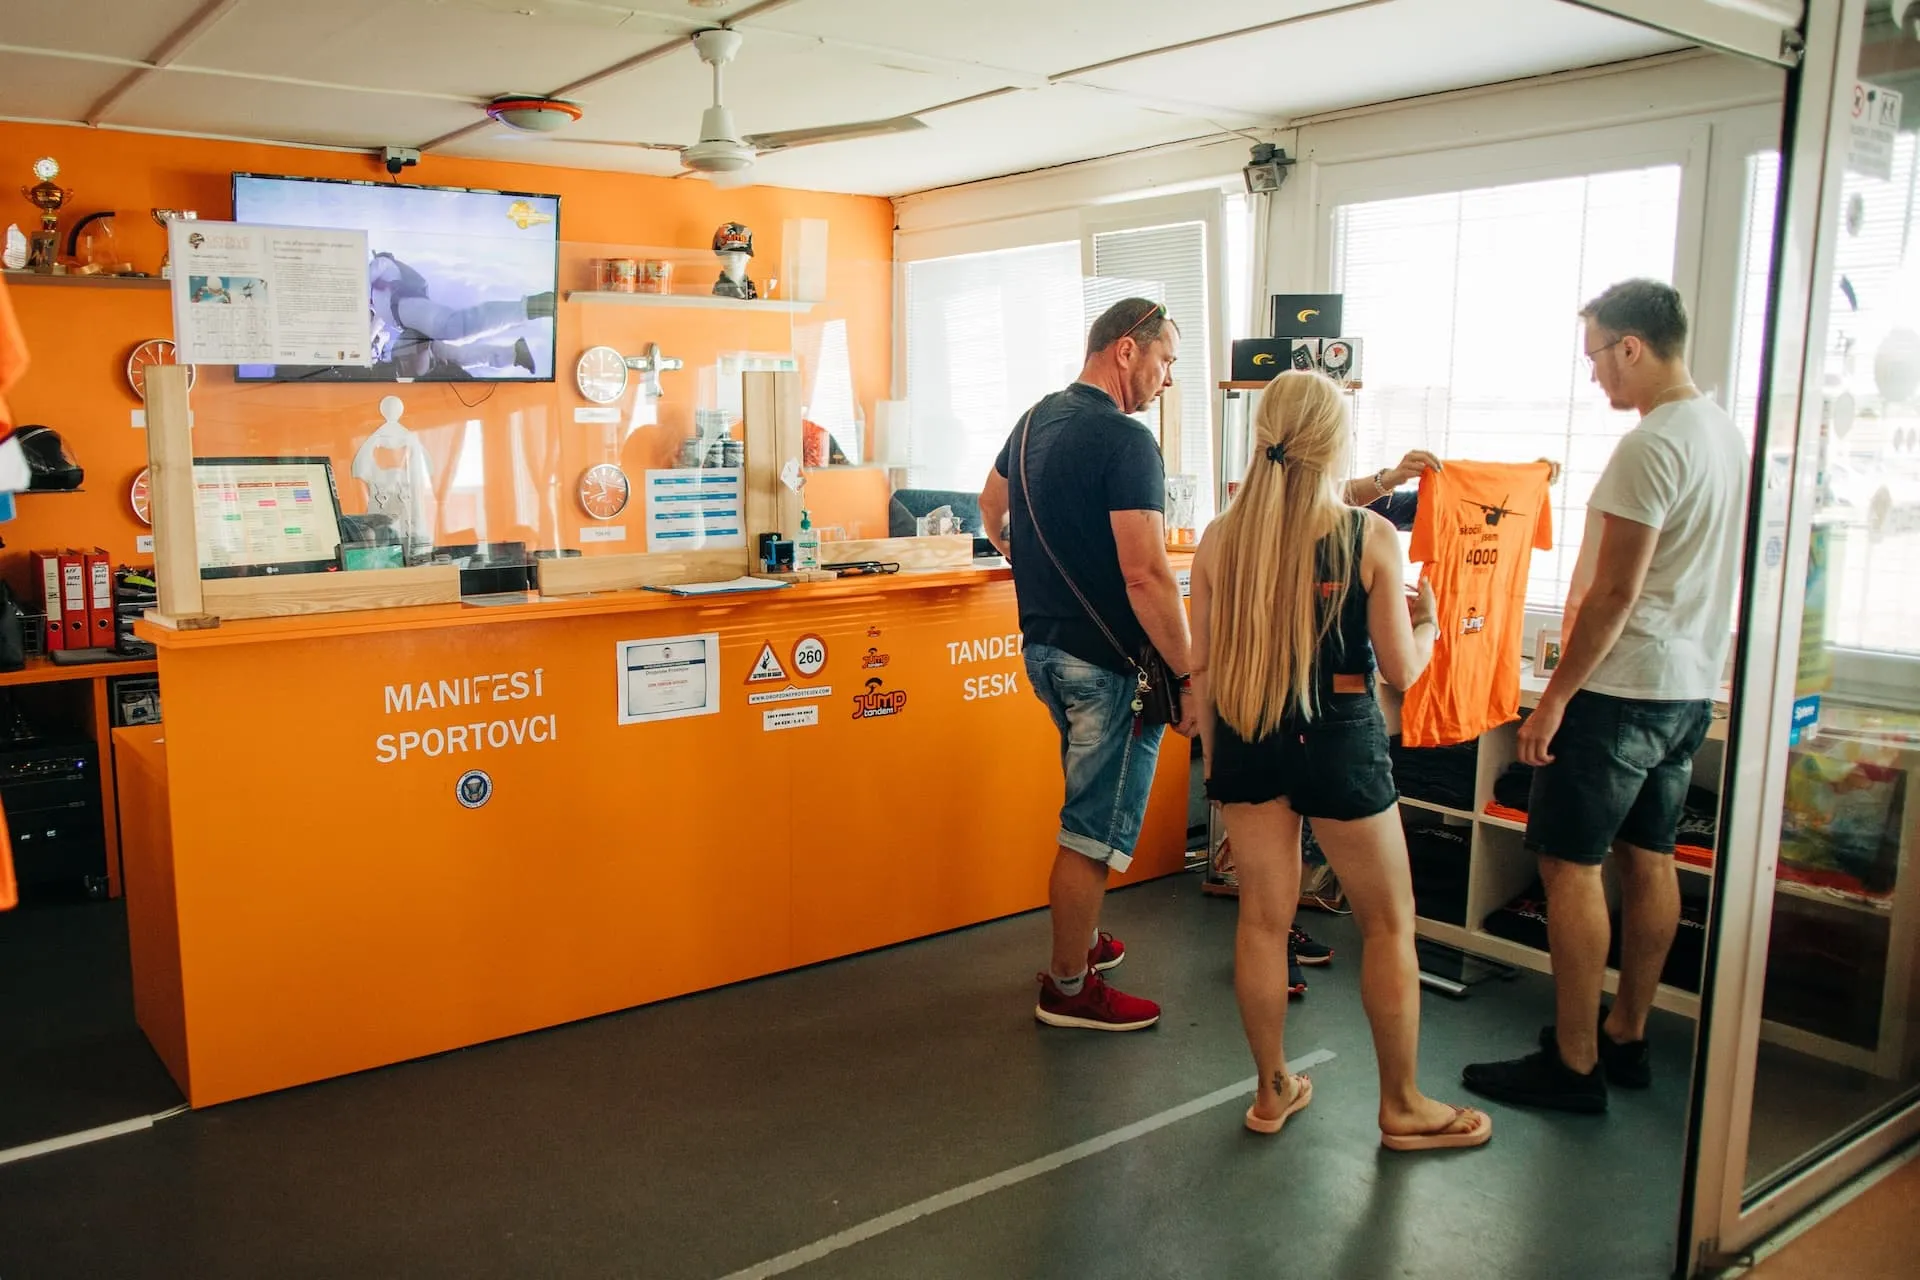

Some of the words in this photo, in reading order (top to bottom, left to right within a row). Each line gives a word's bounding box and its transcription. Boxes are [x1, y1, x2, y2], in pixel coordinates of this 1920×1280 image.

[1466, 548, 1498, 566] 4000
[798, 649, 822, 665] 260
[963, 672, 1018, 701] SESK
[863, 707, 894, 717] tandem
[376, 714, 557, 763] SPORTOVCI
